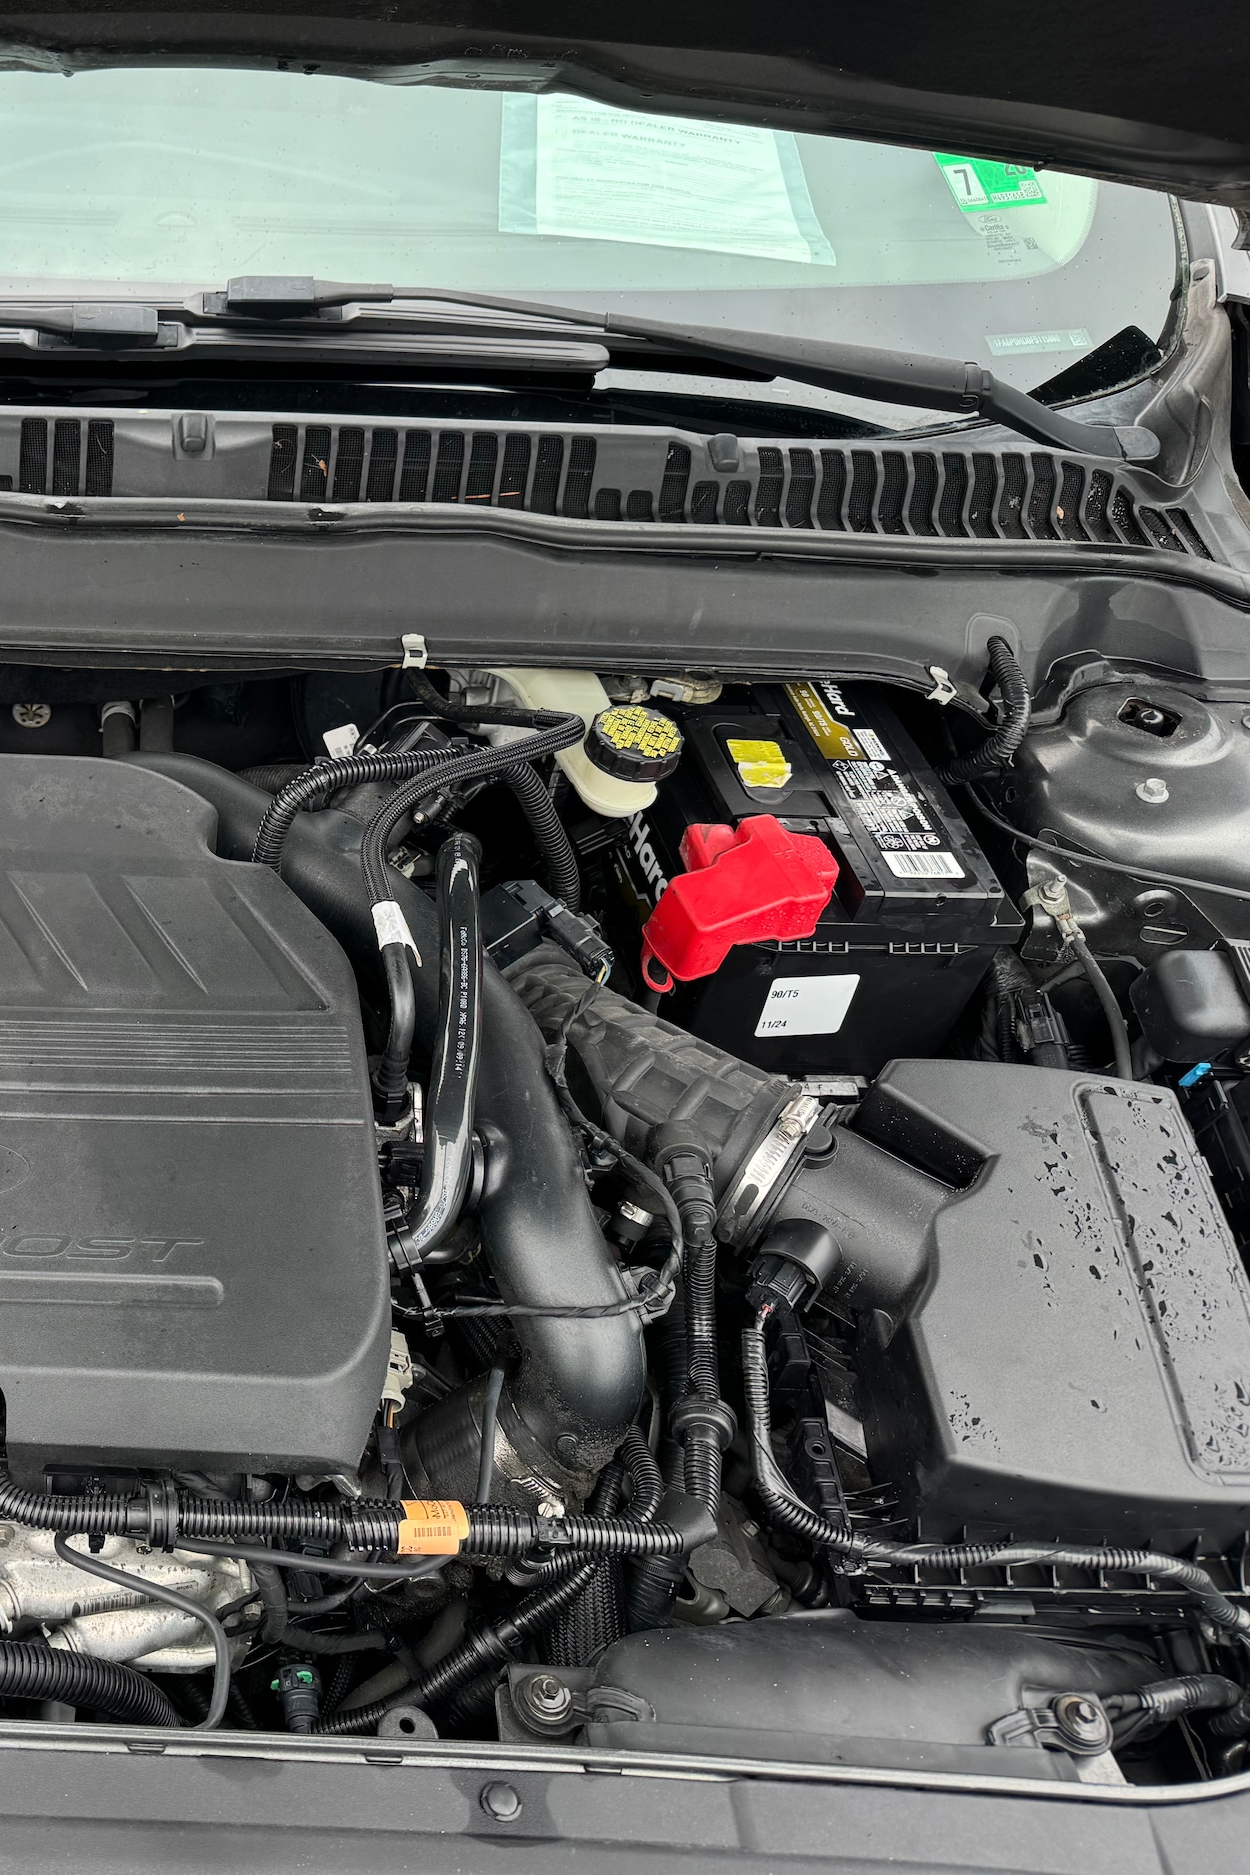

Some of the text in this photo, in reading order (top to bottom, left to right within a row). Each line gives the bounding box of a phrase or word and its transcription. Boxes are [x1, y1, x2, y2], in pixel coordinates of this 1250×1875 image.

[572, 128, 686, 147] DEALER WARRANTY
[630, 120, 675, 131] DEALER
[677, 128, 741, 145] WARRANTY
[953, 168, 972, 196] 7
[820, 681, 856, 716] Hard
[838, 736, 859, 757] GOLD
[771, 989, 800, 999] 90/T5
[761, 1020, 788, 1029] 11/24
